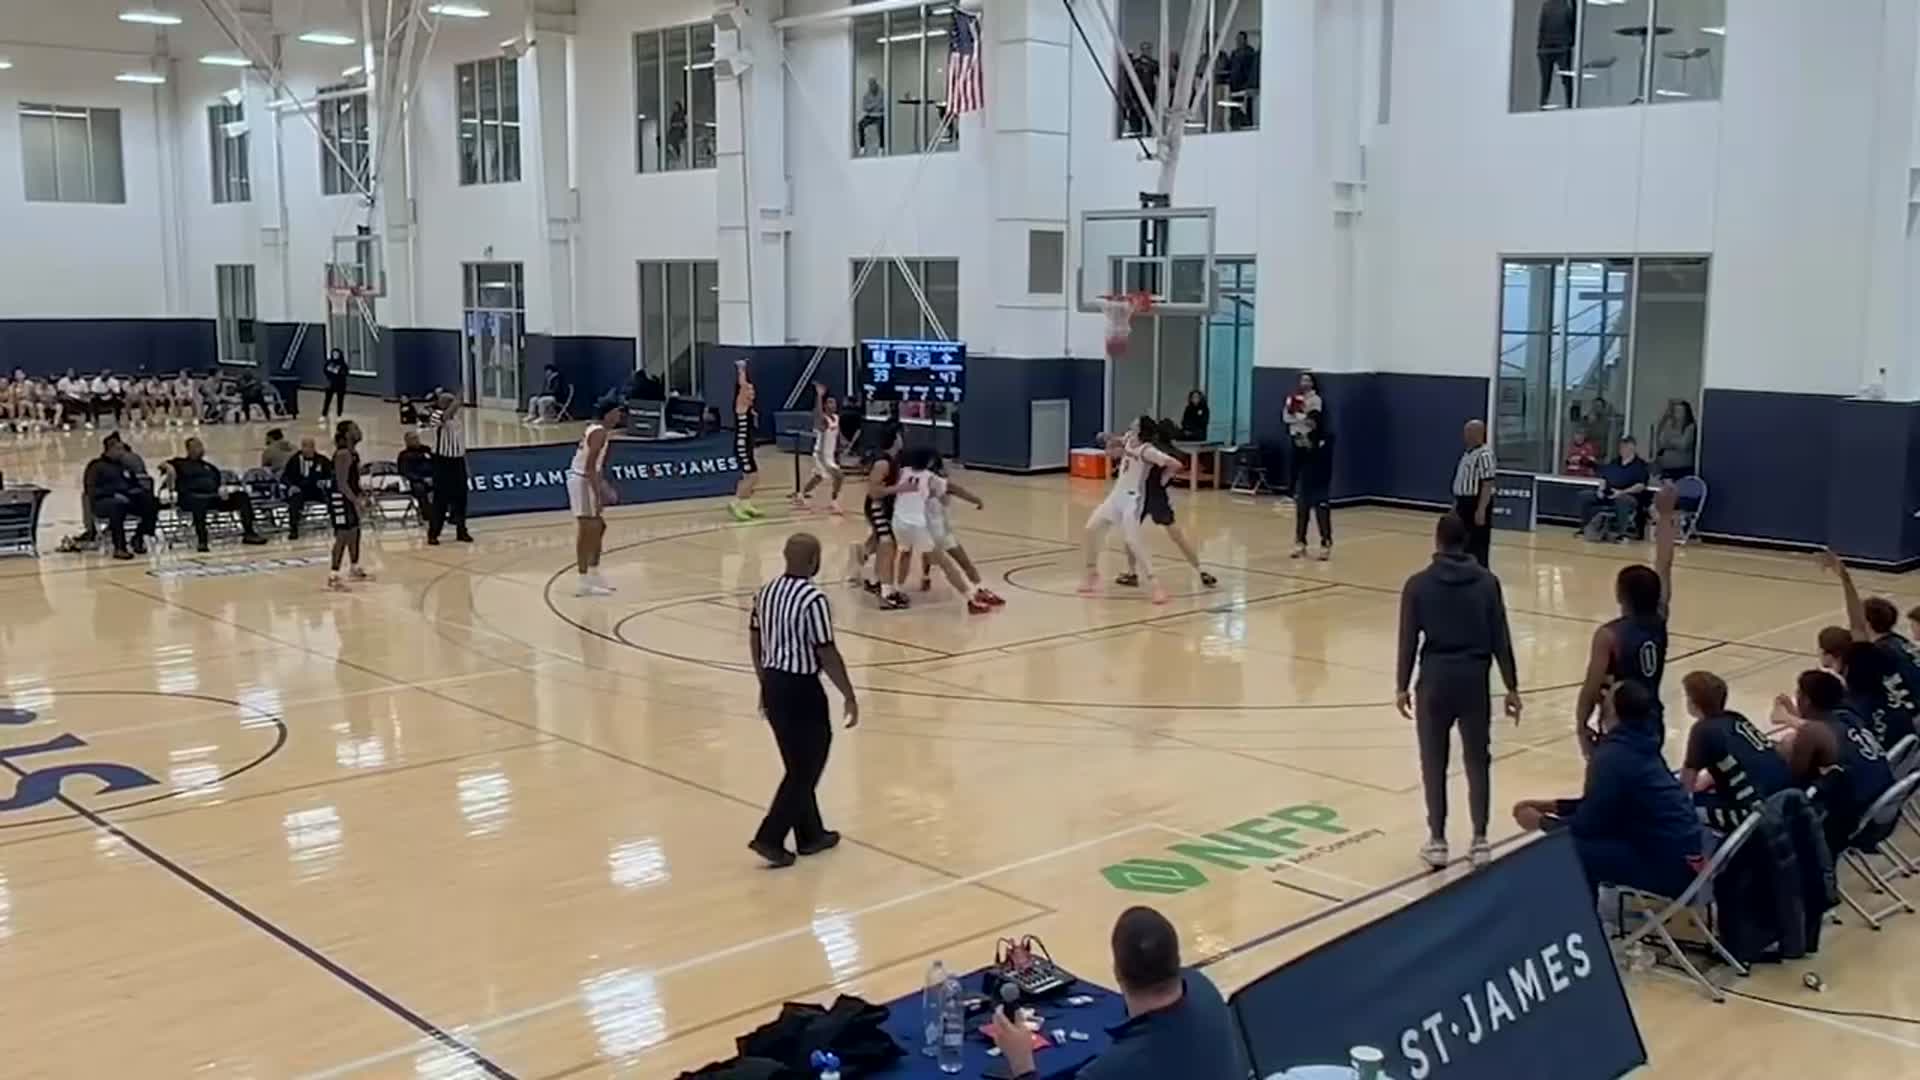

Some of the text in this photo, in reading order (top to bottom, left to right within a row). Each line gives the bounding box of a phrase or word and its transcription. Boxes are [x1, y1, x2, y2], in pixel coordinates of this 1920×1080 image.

[612, 464, 649, 480] THE
[1639, 640, 1658, 678] 0
[1163, 804, 1351, 871] NFP
